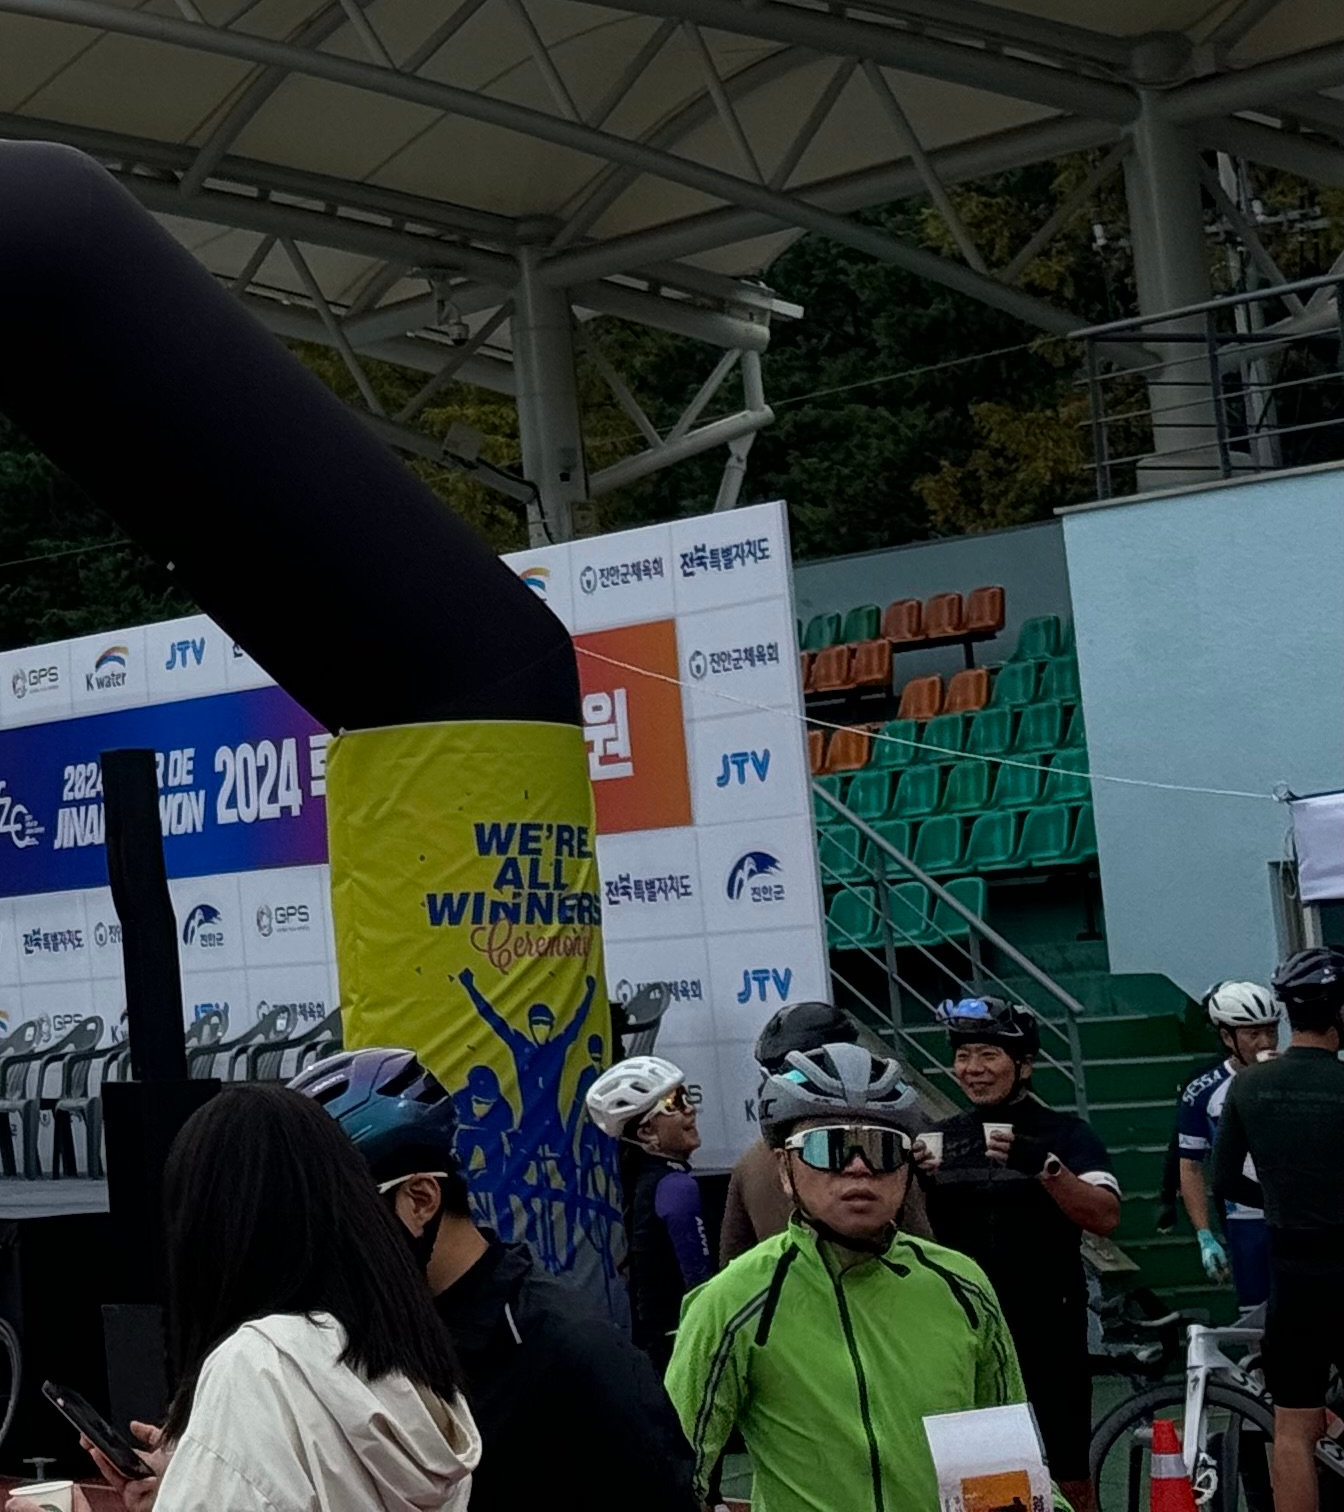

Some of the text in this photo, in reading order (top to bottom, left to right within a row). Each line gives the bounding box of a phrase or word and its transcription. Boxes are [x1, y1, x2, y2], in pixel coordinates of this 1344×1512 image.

[598, 557, 665, 589] 진안군체육회
[165, 636, 206, 671] JTV
[709, 643, 780, 675] 진안군체육회
[28, 665, 59, 686] GPS
[96, 671, 126, 690] water
[168, 748, 196, 787] DE
[214, 737, 304, 826] 2024
[717, 748, 770, 789] JTV
[474, 823, 593, 859] WE'RE
[494, 857, 568, 891] ALL
[427, 891, 602, 926] WINNERS
[750, 884, 785, 903] 진안군
[274, 904, 310, 925] GPS
[737, 967, 792, 1005] JTV
